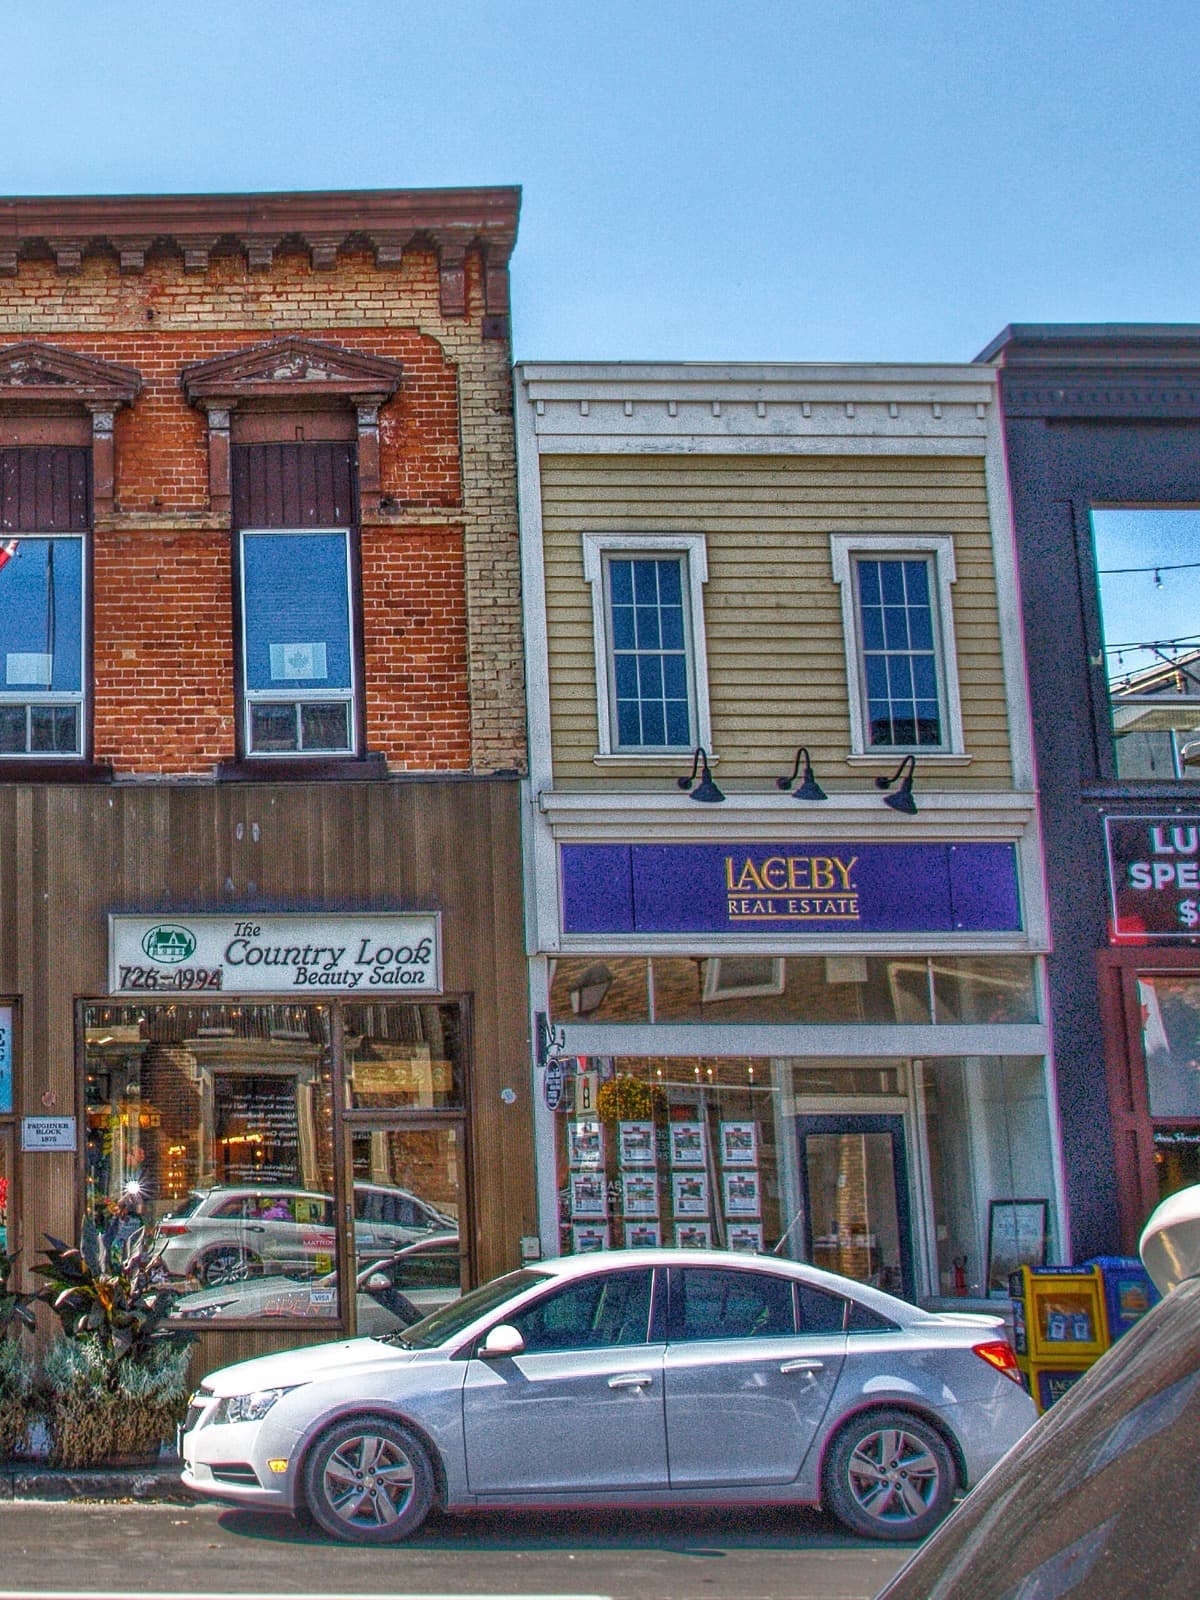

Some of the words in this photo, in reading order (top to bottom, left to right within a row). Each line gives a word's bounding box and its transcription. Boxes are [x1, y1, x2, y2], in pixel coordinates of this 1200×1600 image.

[1129, 862, 1200, 890] SPE
[728, 900, 777, 913] REAL
[789, 900, 859, 913] ESTATE
[234, 922, 261, 937] The
[224, 938, 345, 970] Country
[354, 937, 432, 966] Look
[293, 967, 363, 987] Beauty
[369, 966, 425, 985] Salon
[314, 1294, 331, 1302] VISA
